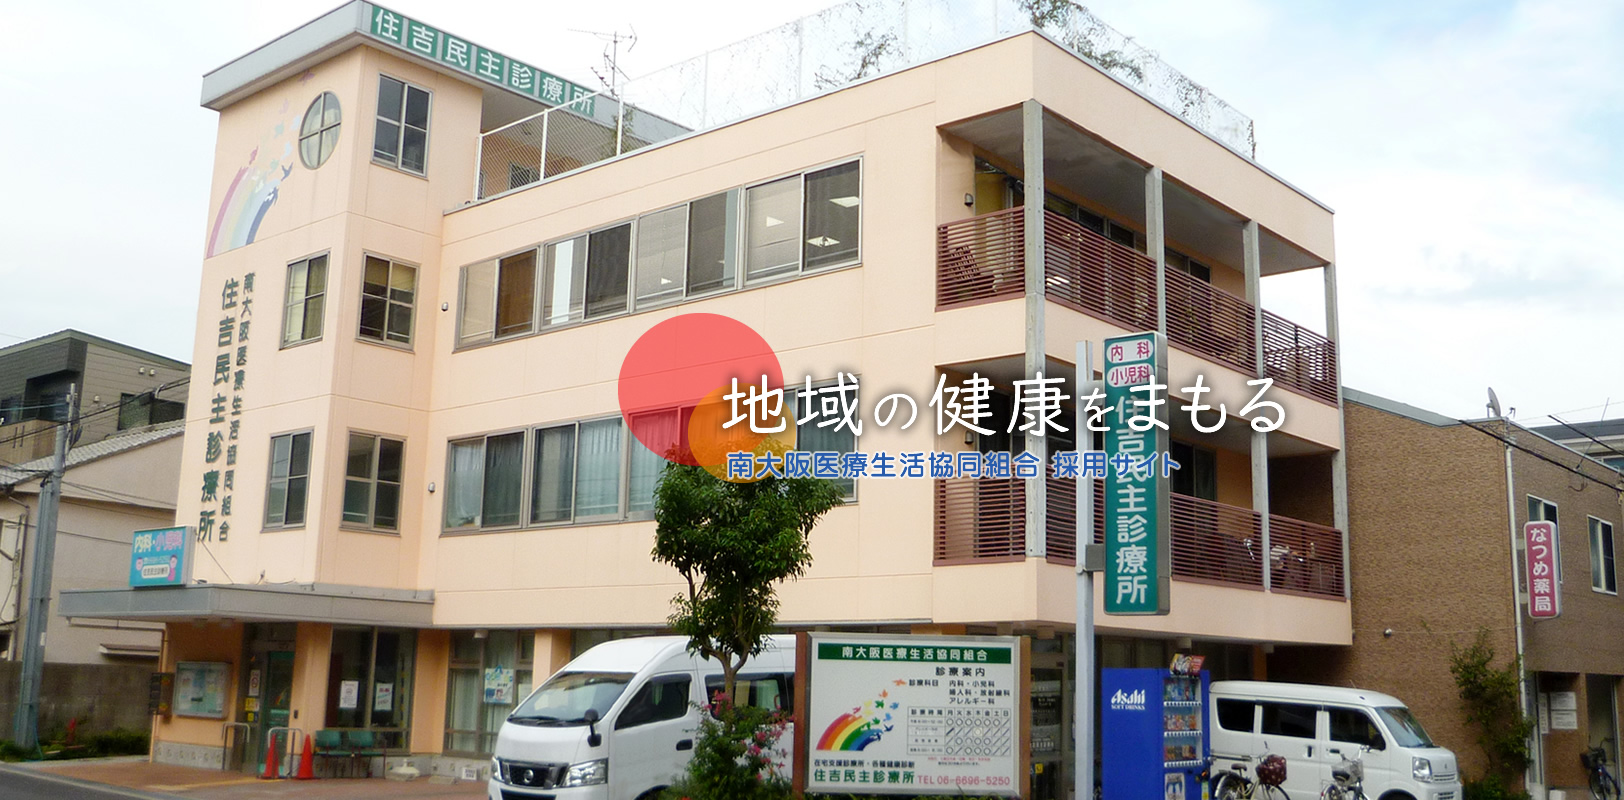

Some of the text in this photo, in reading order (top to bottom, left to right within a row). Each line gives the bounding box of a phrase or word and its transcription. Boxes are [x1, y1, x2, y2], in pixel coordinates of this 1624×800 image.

[375, 9, 593, 114] 住吉民主診療所
[1111, 341, 1150, 362] 内科
[1111, 365, 1151, 385] 小児科
[197, 277, 239, 543] 住吉民主診療所
[219, 272, 256, 543] 南大阪医療生活協同組合
[1530, 527, 1551, 612] なつめ薬局
[842, 646, 988, 661] 南大阪医療生活協同組合
[935, 666, 986, 677] 診療案内
[949, 680, 995, 688] 内科・小児科
[949, 697, 995, 705] アレルギー科
[1111, 689, 1145, 704] Asahi
[814, 769, 914, 784] 住吉民主診療所
[917, 775, 1011, 786] TEL 06-6696-5250
